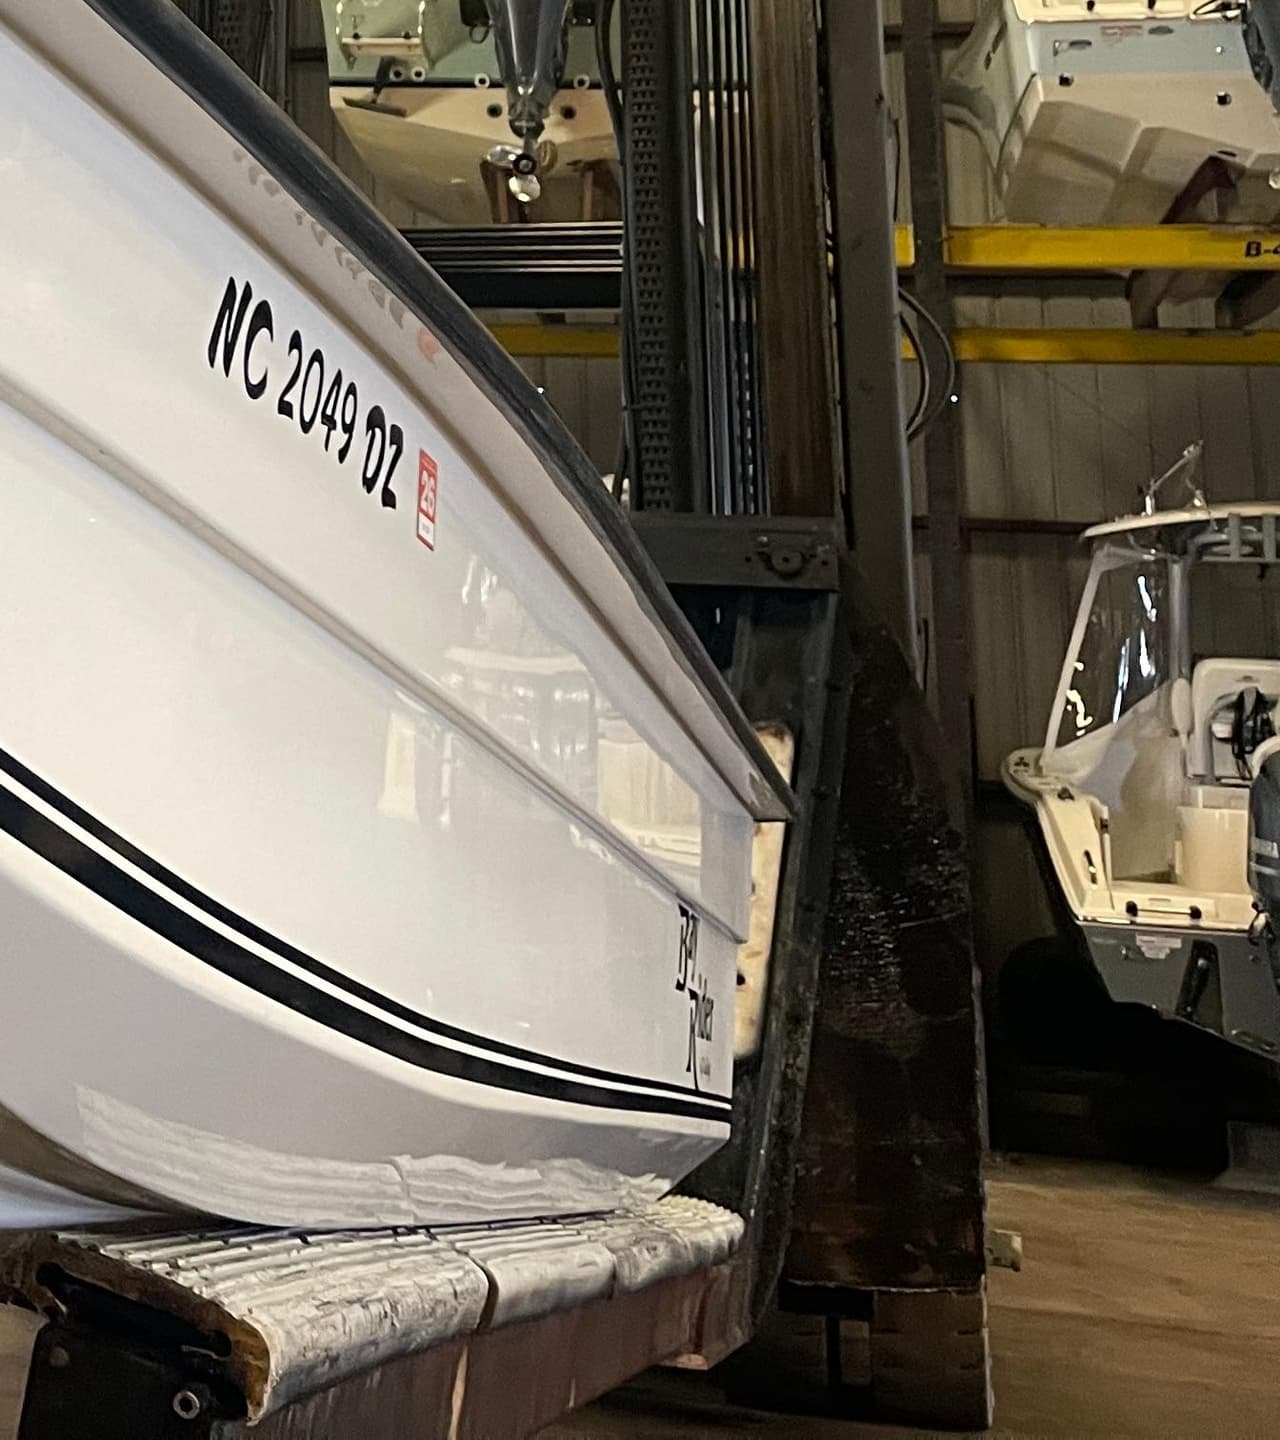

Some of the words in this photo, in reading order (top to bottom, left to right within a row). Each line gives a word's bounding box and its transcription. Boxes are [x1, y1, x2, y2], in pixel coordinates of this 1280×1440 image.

[207, 276, 274, 400] NC
[277, 329, 358, 465] 2049
[419, 469, 436, 519] 26
